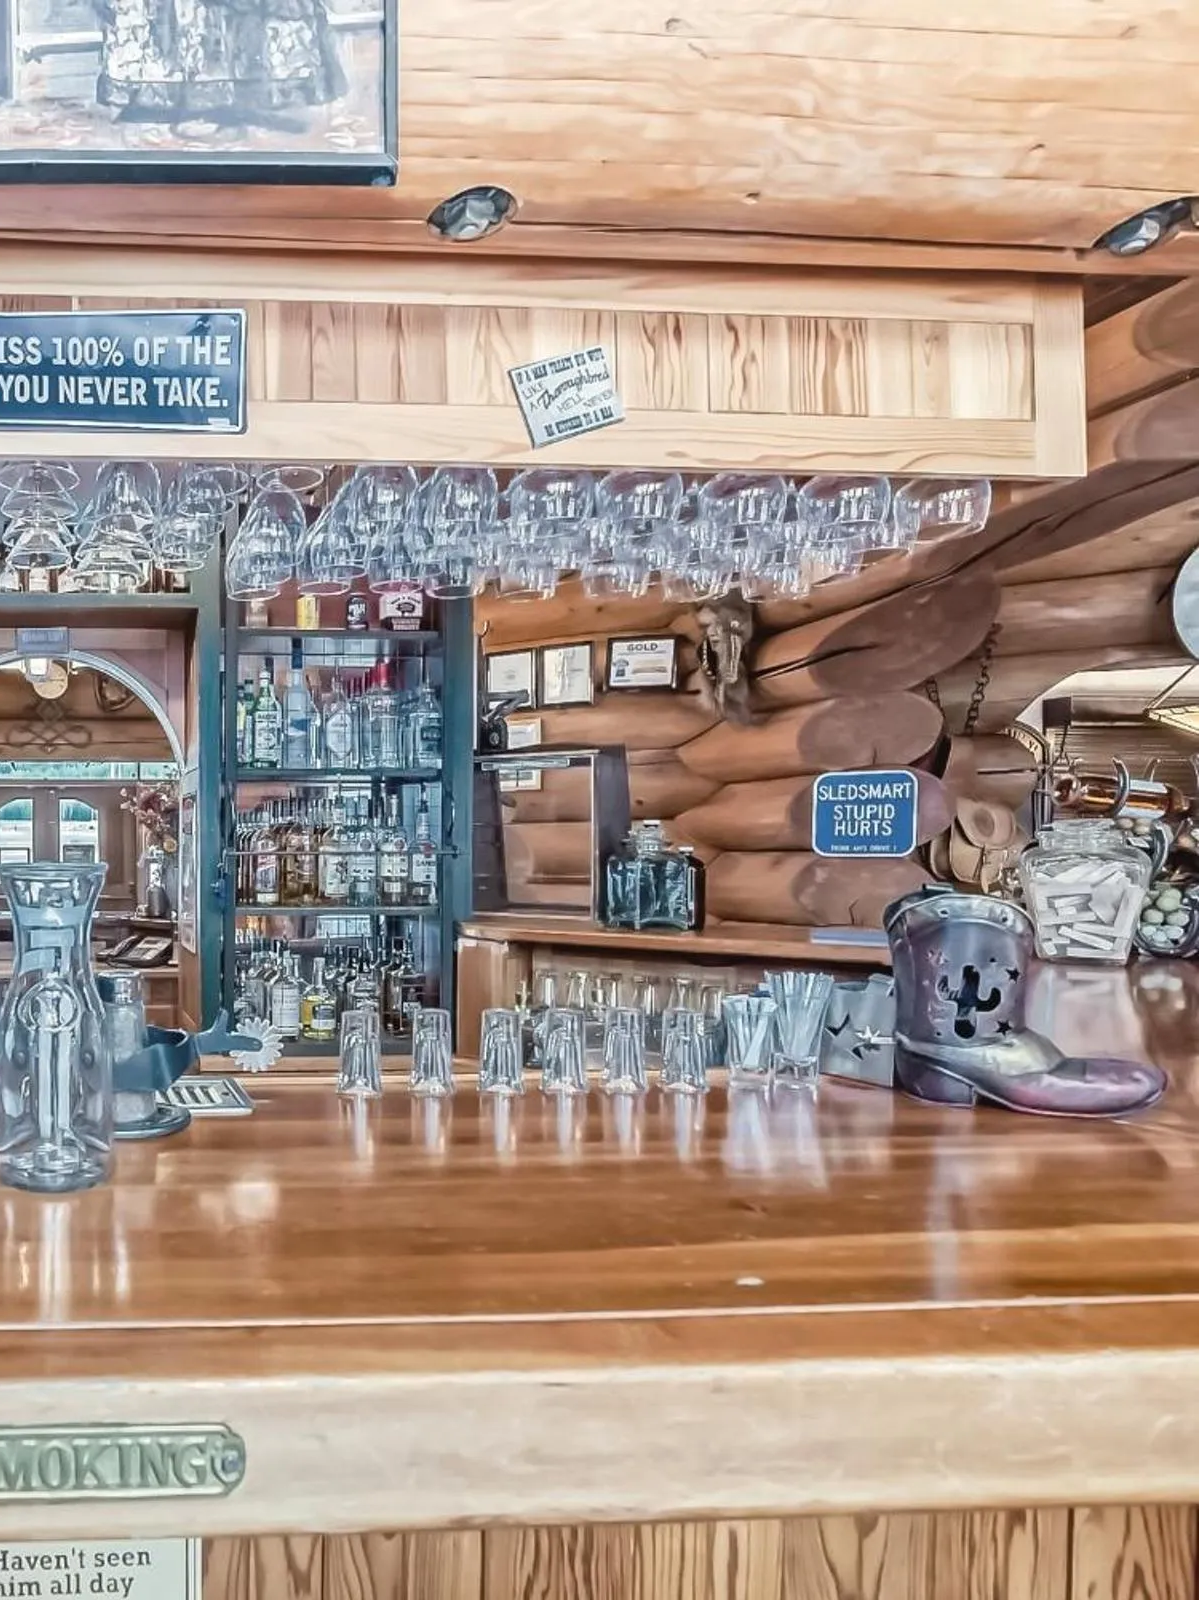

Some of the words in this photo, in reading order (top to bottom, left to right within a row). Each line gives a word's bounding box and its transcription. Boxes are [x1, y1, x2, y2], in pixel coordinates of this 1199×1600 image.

[52, 336, 124, 367] 100%
[134, 336, 170, 366] OF
[176, 335, 231, 365] THE
[58, 376, 148, 406] NEVER
[153, 377, 229, 407] TAKE.
[627, 643, 658, 651] GOLD
[818, 782, 912, 801] SLEDSMART
[833, 804, 895, 820] STUPID
[834, 820, 893, 837] HURTS
[94, 1550, 151, 1568] seen
[50, 1573, 82, 1595] all
[90, 1572, 134, 1598] day
